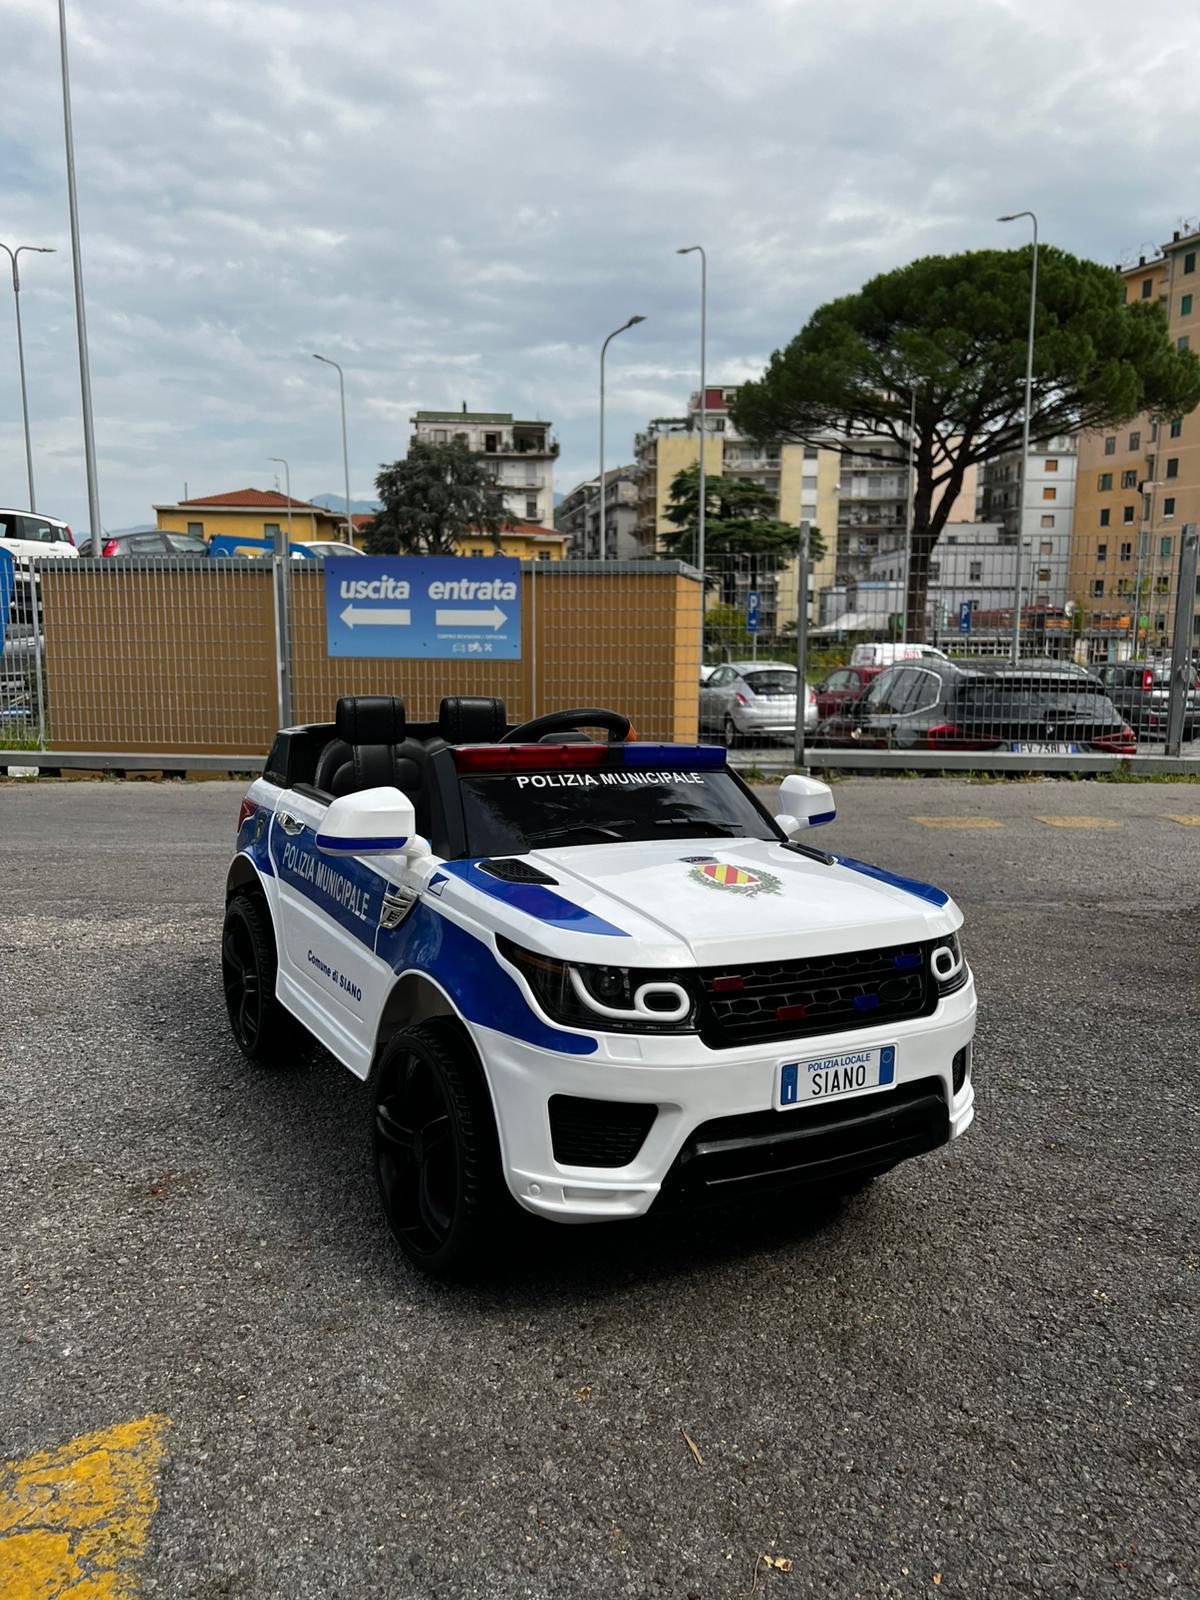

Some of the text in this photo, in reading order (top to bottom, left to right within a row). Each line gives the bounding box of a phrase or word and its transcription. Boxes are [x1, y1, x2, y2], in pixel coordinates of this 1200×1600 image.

[340, 575, 410, 600] uscita
[428, 578, 517, 600] entrata
[750, 594, 758, 614] P
[961, 604, 969, 619] P
[516, 771, 705, 788] POLIZIA MUNICIPALE
[282, 842, 371, 921] POLIZIA MUNICIPALE
[307, 949, 363, 1002] Comune di SIANO
[807, 1053, 871, 1073] POLIZIA LOCALE
[812, 1065, 866, 1095] SIANO
